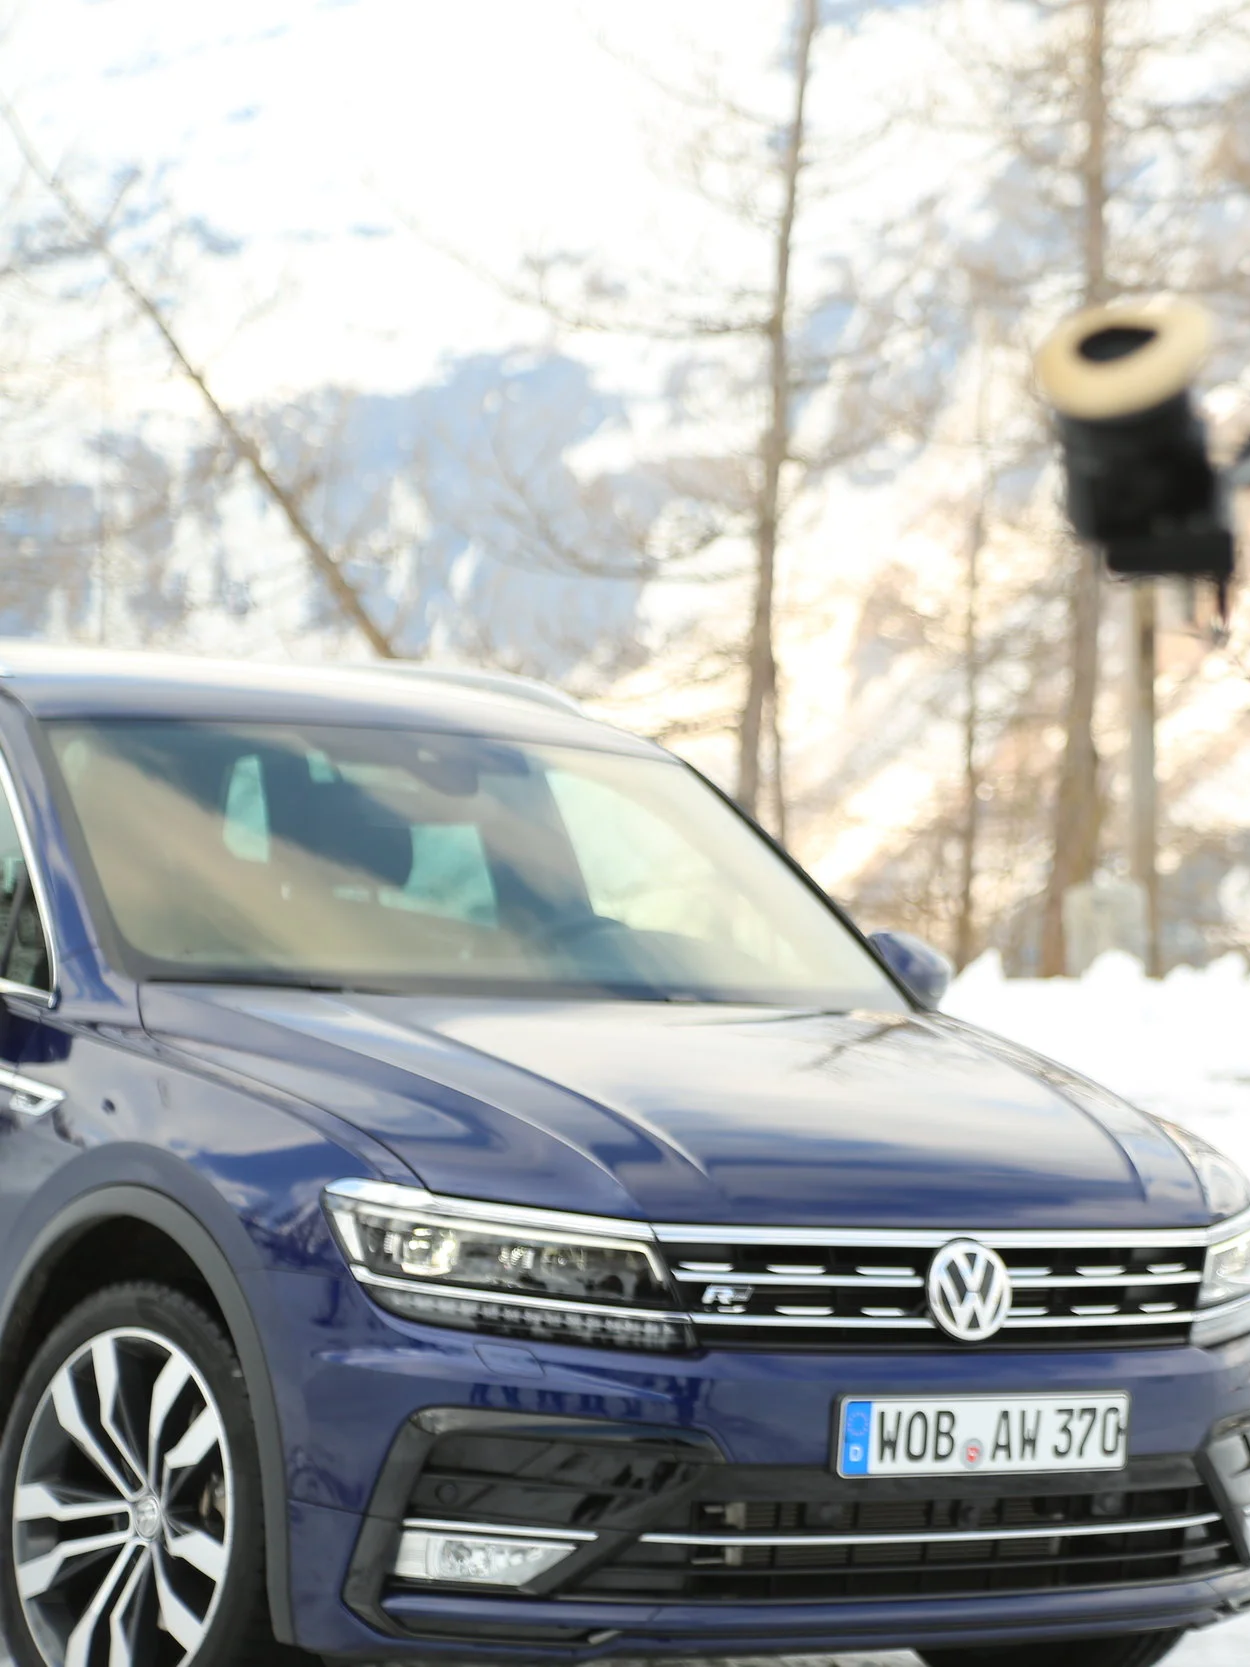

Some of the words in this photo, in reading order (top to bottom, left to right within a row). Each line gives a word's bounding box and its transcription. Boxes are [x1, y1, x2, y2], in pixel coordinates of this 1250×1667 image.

[876, 1409, 956, 1463] WOB
[990, 1408, 1042, 1462] AW
[1053, 1407, 1122, 1458] 370
